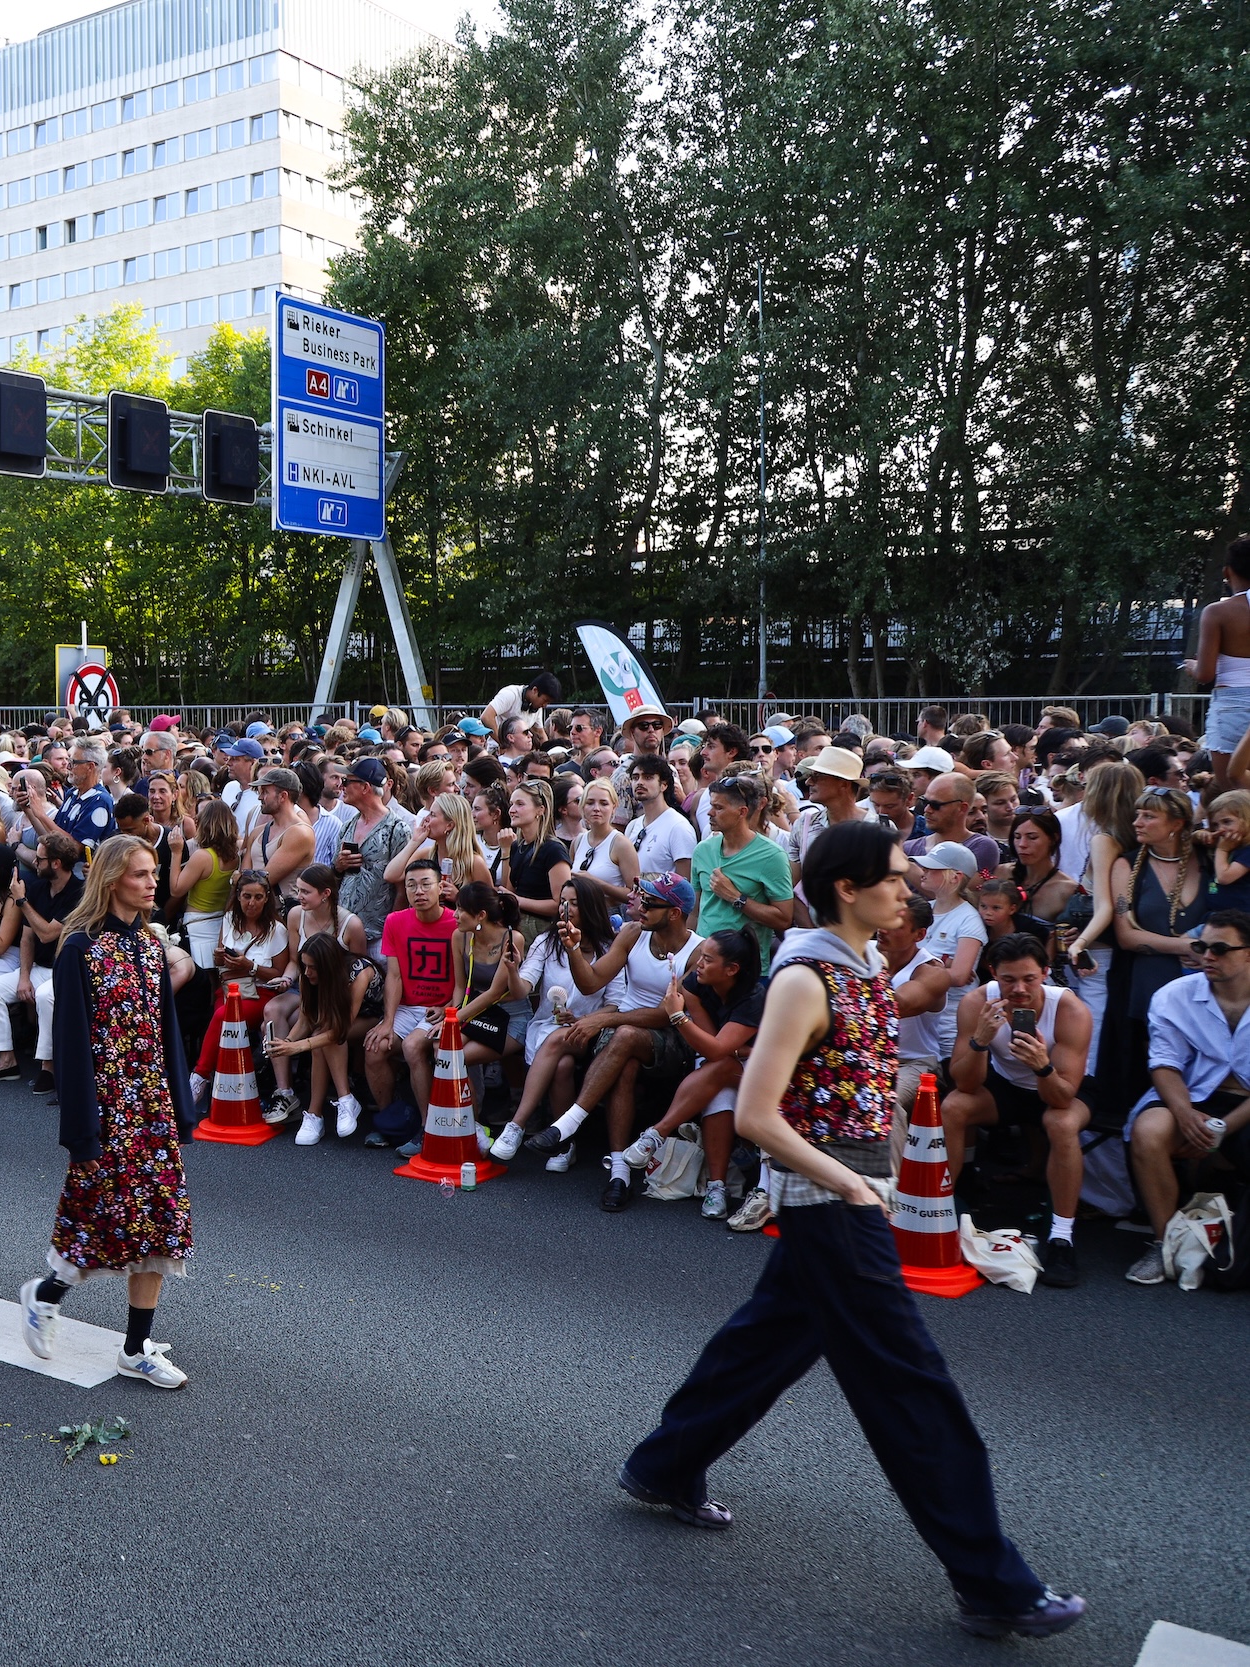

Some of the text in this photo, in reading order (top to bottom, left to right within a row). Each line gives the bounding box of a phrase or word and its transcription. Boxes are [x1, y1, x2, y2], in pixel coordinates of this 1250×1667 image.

[302, 314, 341, 339] Rieker
[303, 337, 376, 371] Business Park
[309, 374, 328, 394] A4
[350, 385, 355, 399] 1
[302, 418, 353, 443] Schinkel
[303, 466, 356, 489] NKI-AVL
[336, 506, 343, 521] 7
[415, 945, 442, 975] 力
[222, 1029, 240, 1039] AFW
[482, 1022, 499, 1033] CLUB
[215, 1082, 243, 1095] KEUNE
[434, 1115, 468, 1128] KEUNE
[919, 1208, 953, 1218] GUESTS
